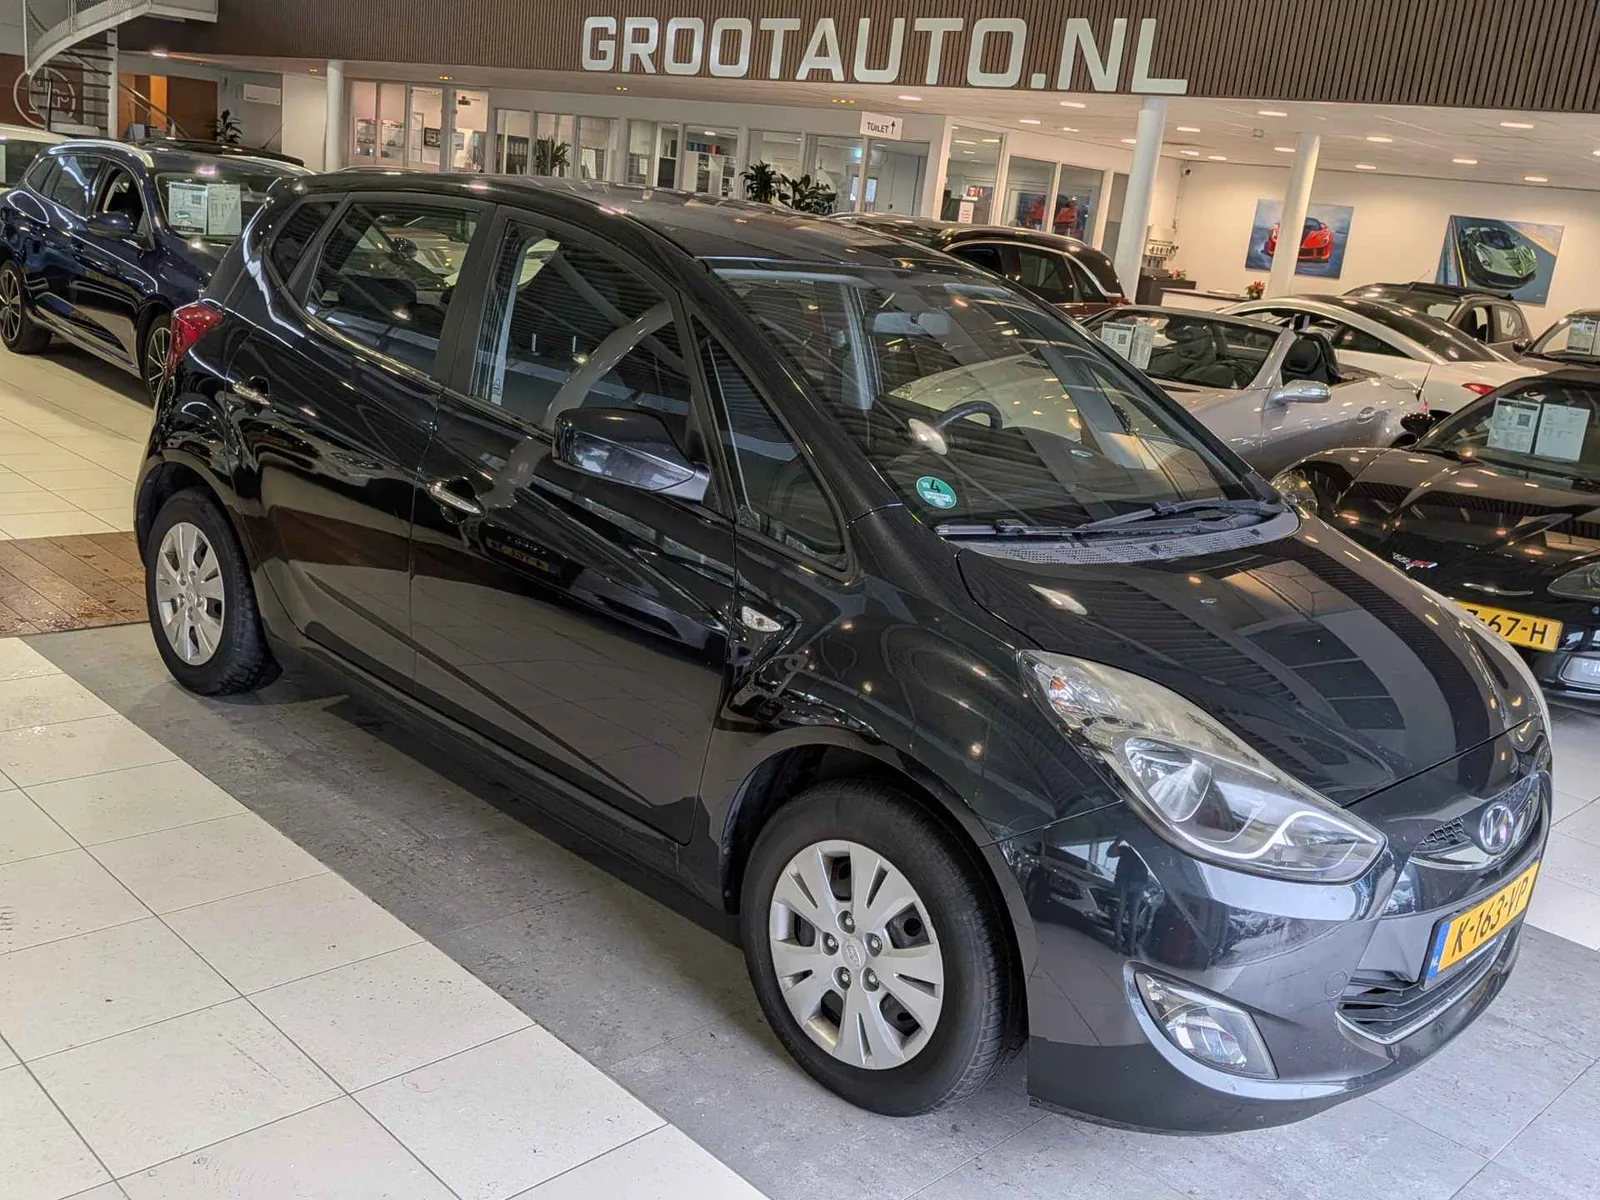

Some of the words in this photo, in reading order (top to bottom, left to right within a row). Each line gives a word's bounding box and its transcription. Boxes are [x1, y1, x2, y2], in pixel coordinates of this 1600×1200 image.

[582, 16, 1188, 94] GROOTAUTO.NL
[866, 121, 889, 134] TOILET
[931, 479, 941, 493] 4
[1451, 876, 1529, 957] K-163-VP
